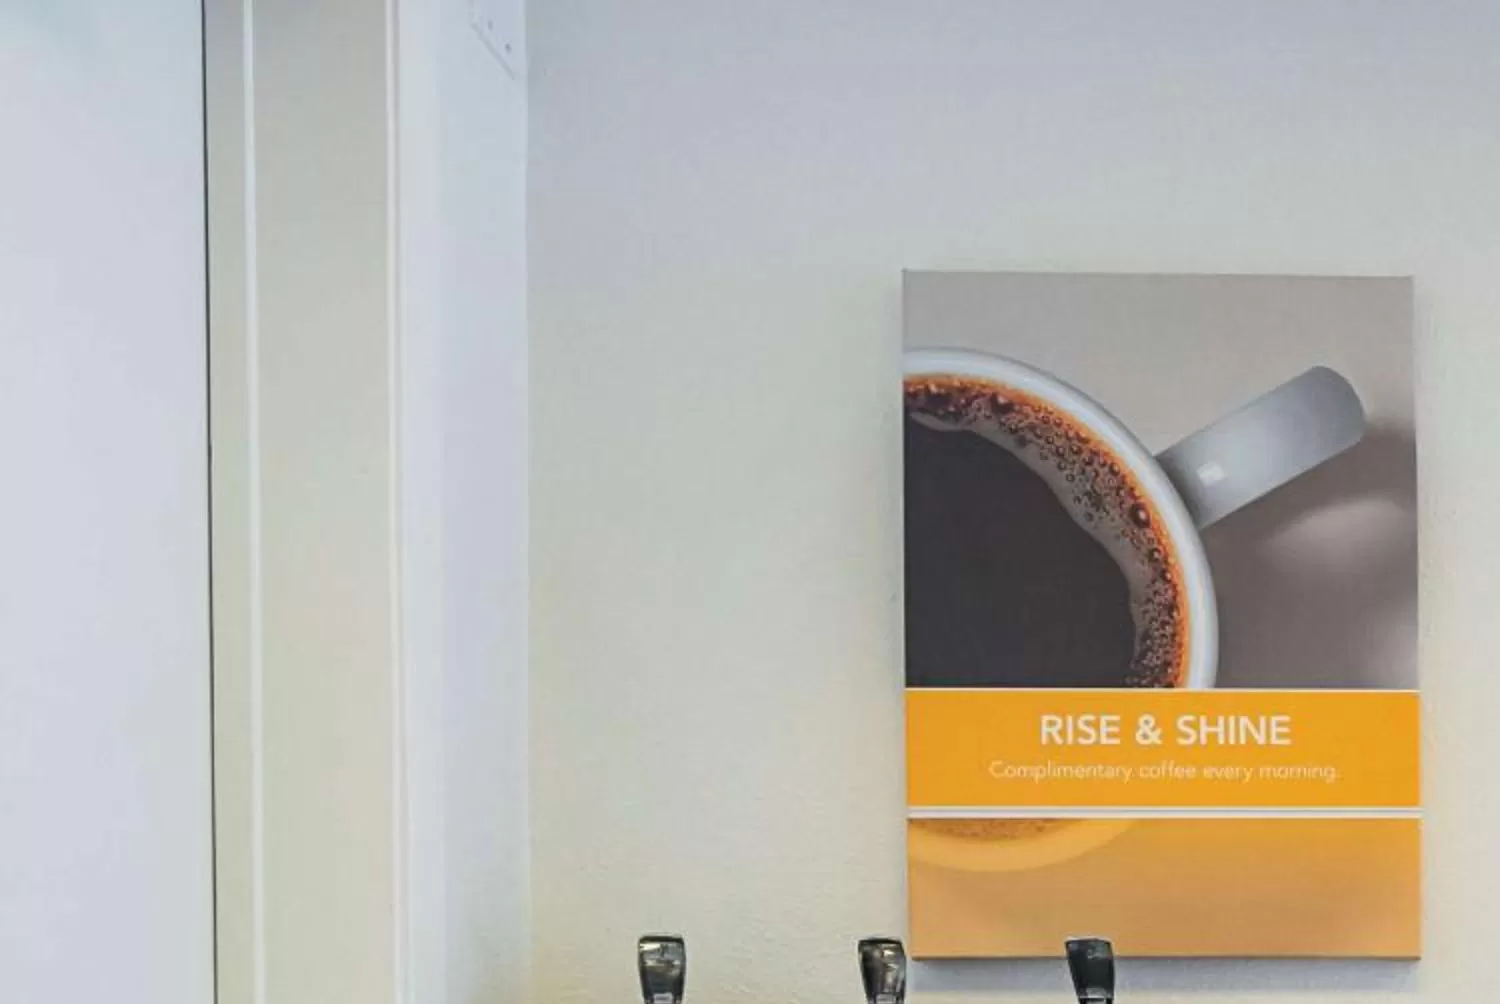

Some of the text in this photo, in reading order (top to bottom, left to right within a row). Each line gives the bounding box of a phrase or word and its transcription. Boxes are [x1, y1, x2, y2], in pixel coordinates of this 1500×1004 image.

[1040, 714, 1292, 746] RISE & SHINE
[988, 759, 1340, 784] Complimentary coffee every morning.
